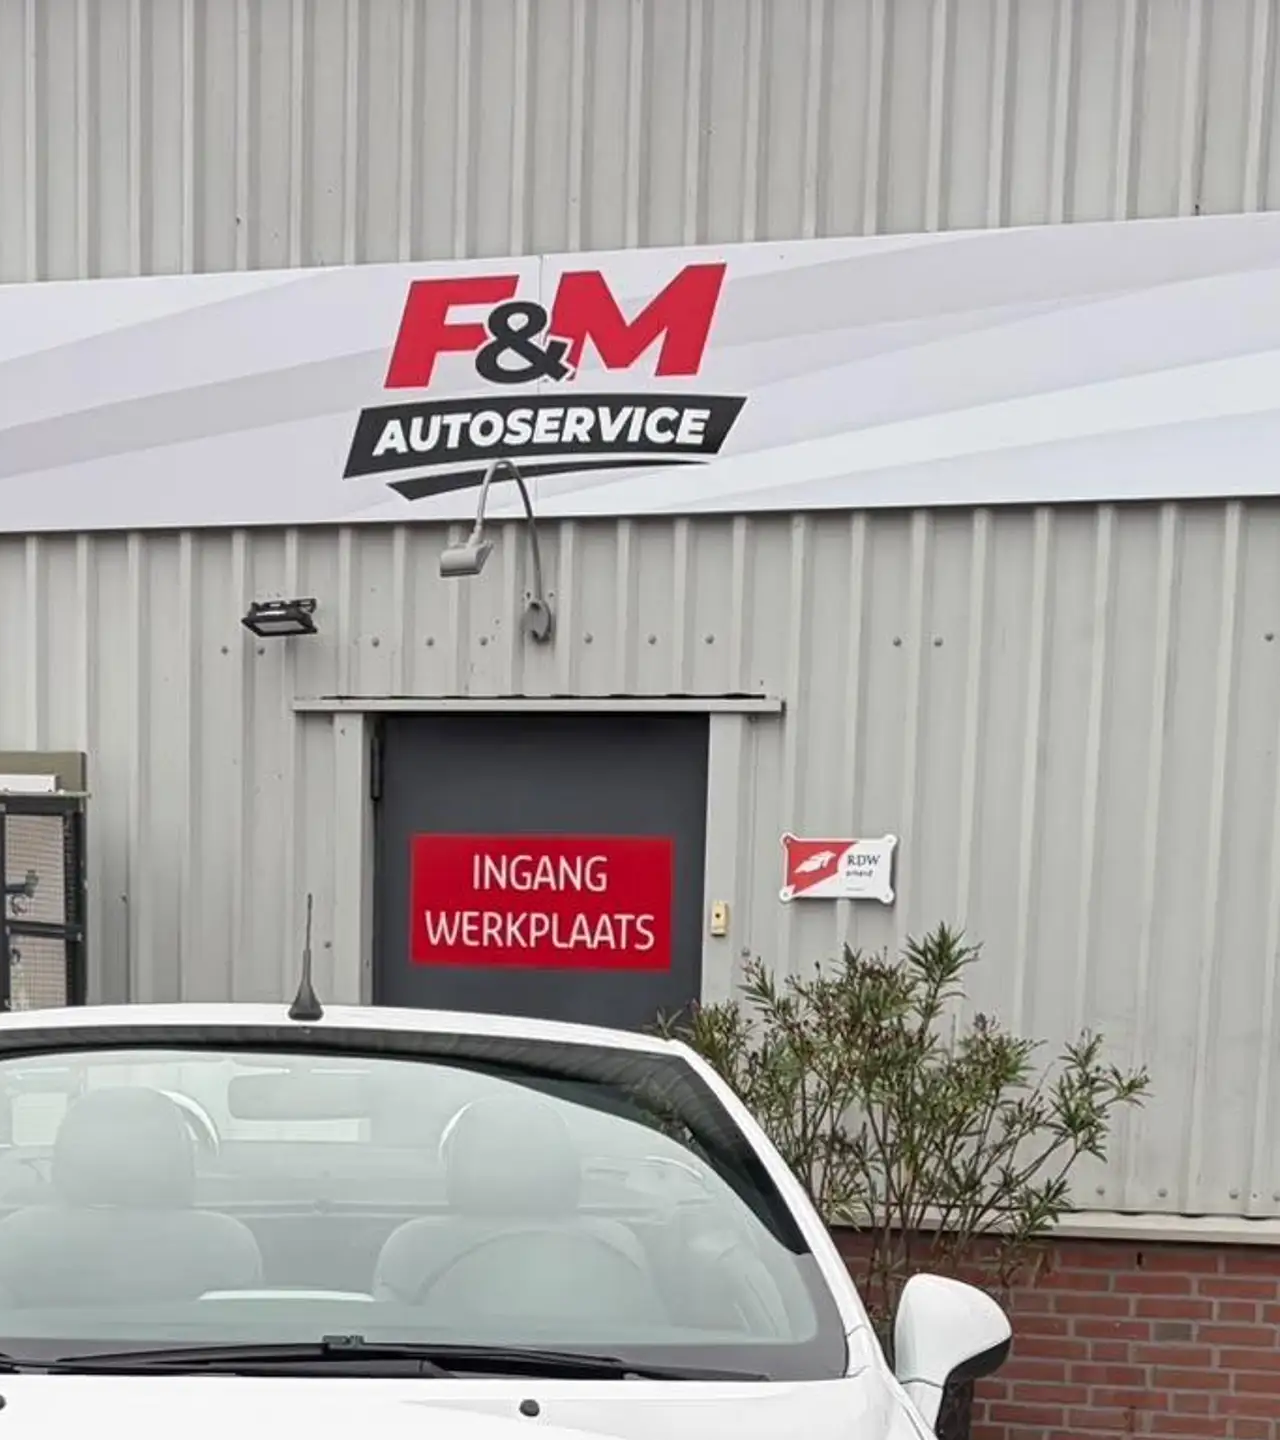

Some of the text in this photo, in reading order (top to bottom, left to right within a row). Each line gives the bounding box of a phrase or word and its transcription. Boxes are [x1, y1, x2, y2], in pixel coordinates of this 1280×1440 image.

[384, 263, 727, 388] F&M
[372, 407, 711, 456] AUTOSERVICE
[472, 853, 609, 892] INGANG
[424, 910, 655, 951] WERKPLAATS
